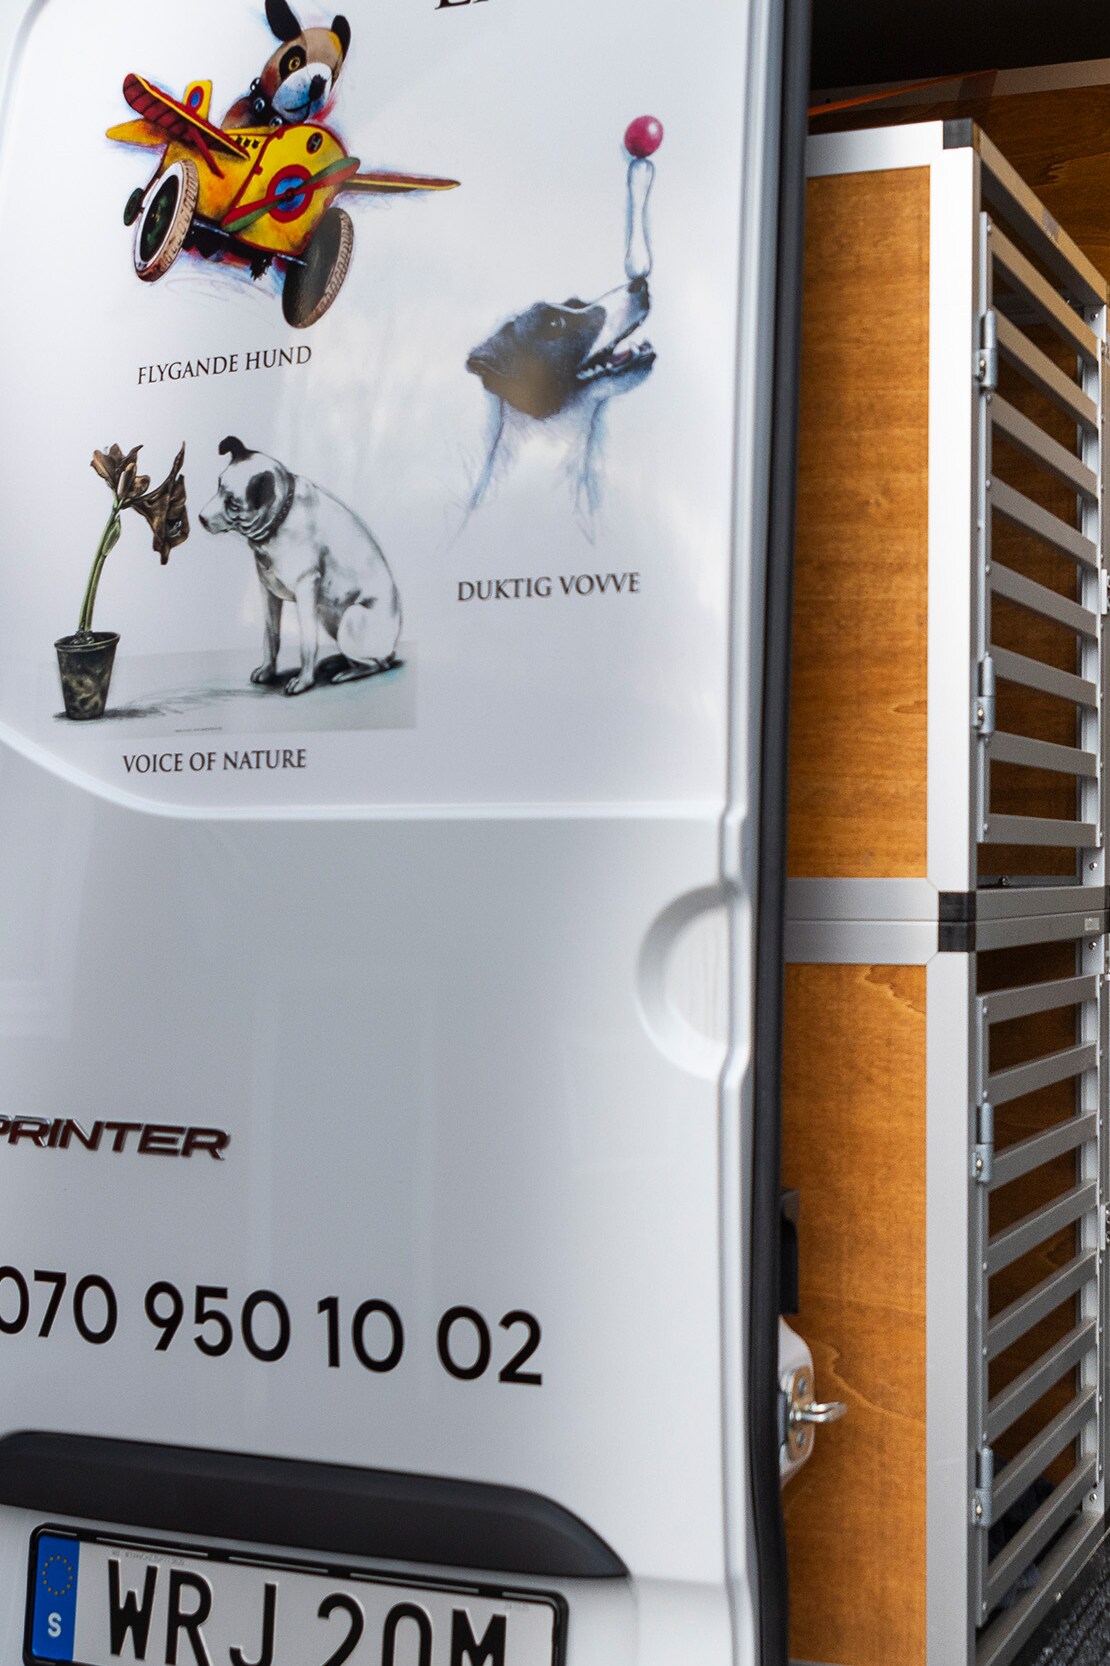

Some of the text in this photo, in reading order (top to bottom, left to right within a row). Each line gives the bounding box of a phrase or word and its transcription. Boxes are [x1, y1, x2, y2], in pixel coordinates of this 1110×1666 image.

[137, 345, 312, 386] FLYGANDE HUND
[457, 572, 641, 602] DUKTIG VOVVE
[122, 748, 307, 774] VOICE OF NATURE
[0, 1265, 543, 1386] 070 950 10 02
[47, 1611, 62, 1638] S
[108, 1558, 279, 1666] WRJ
